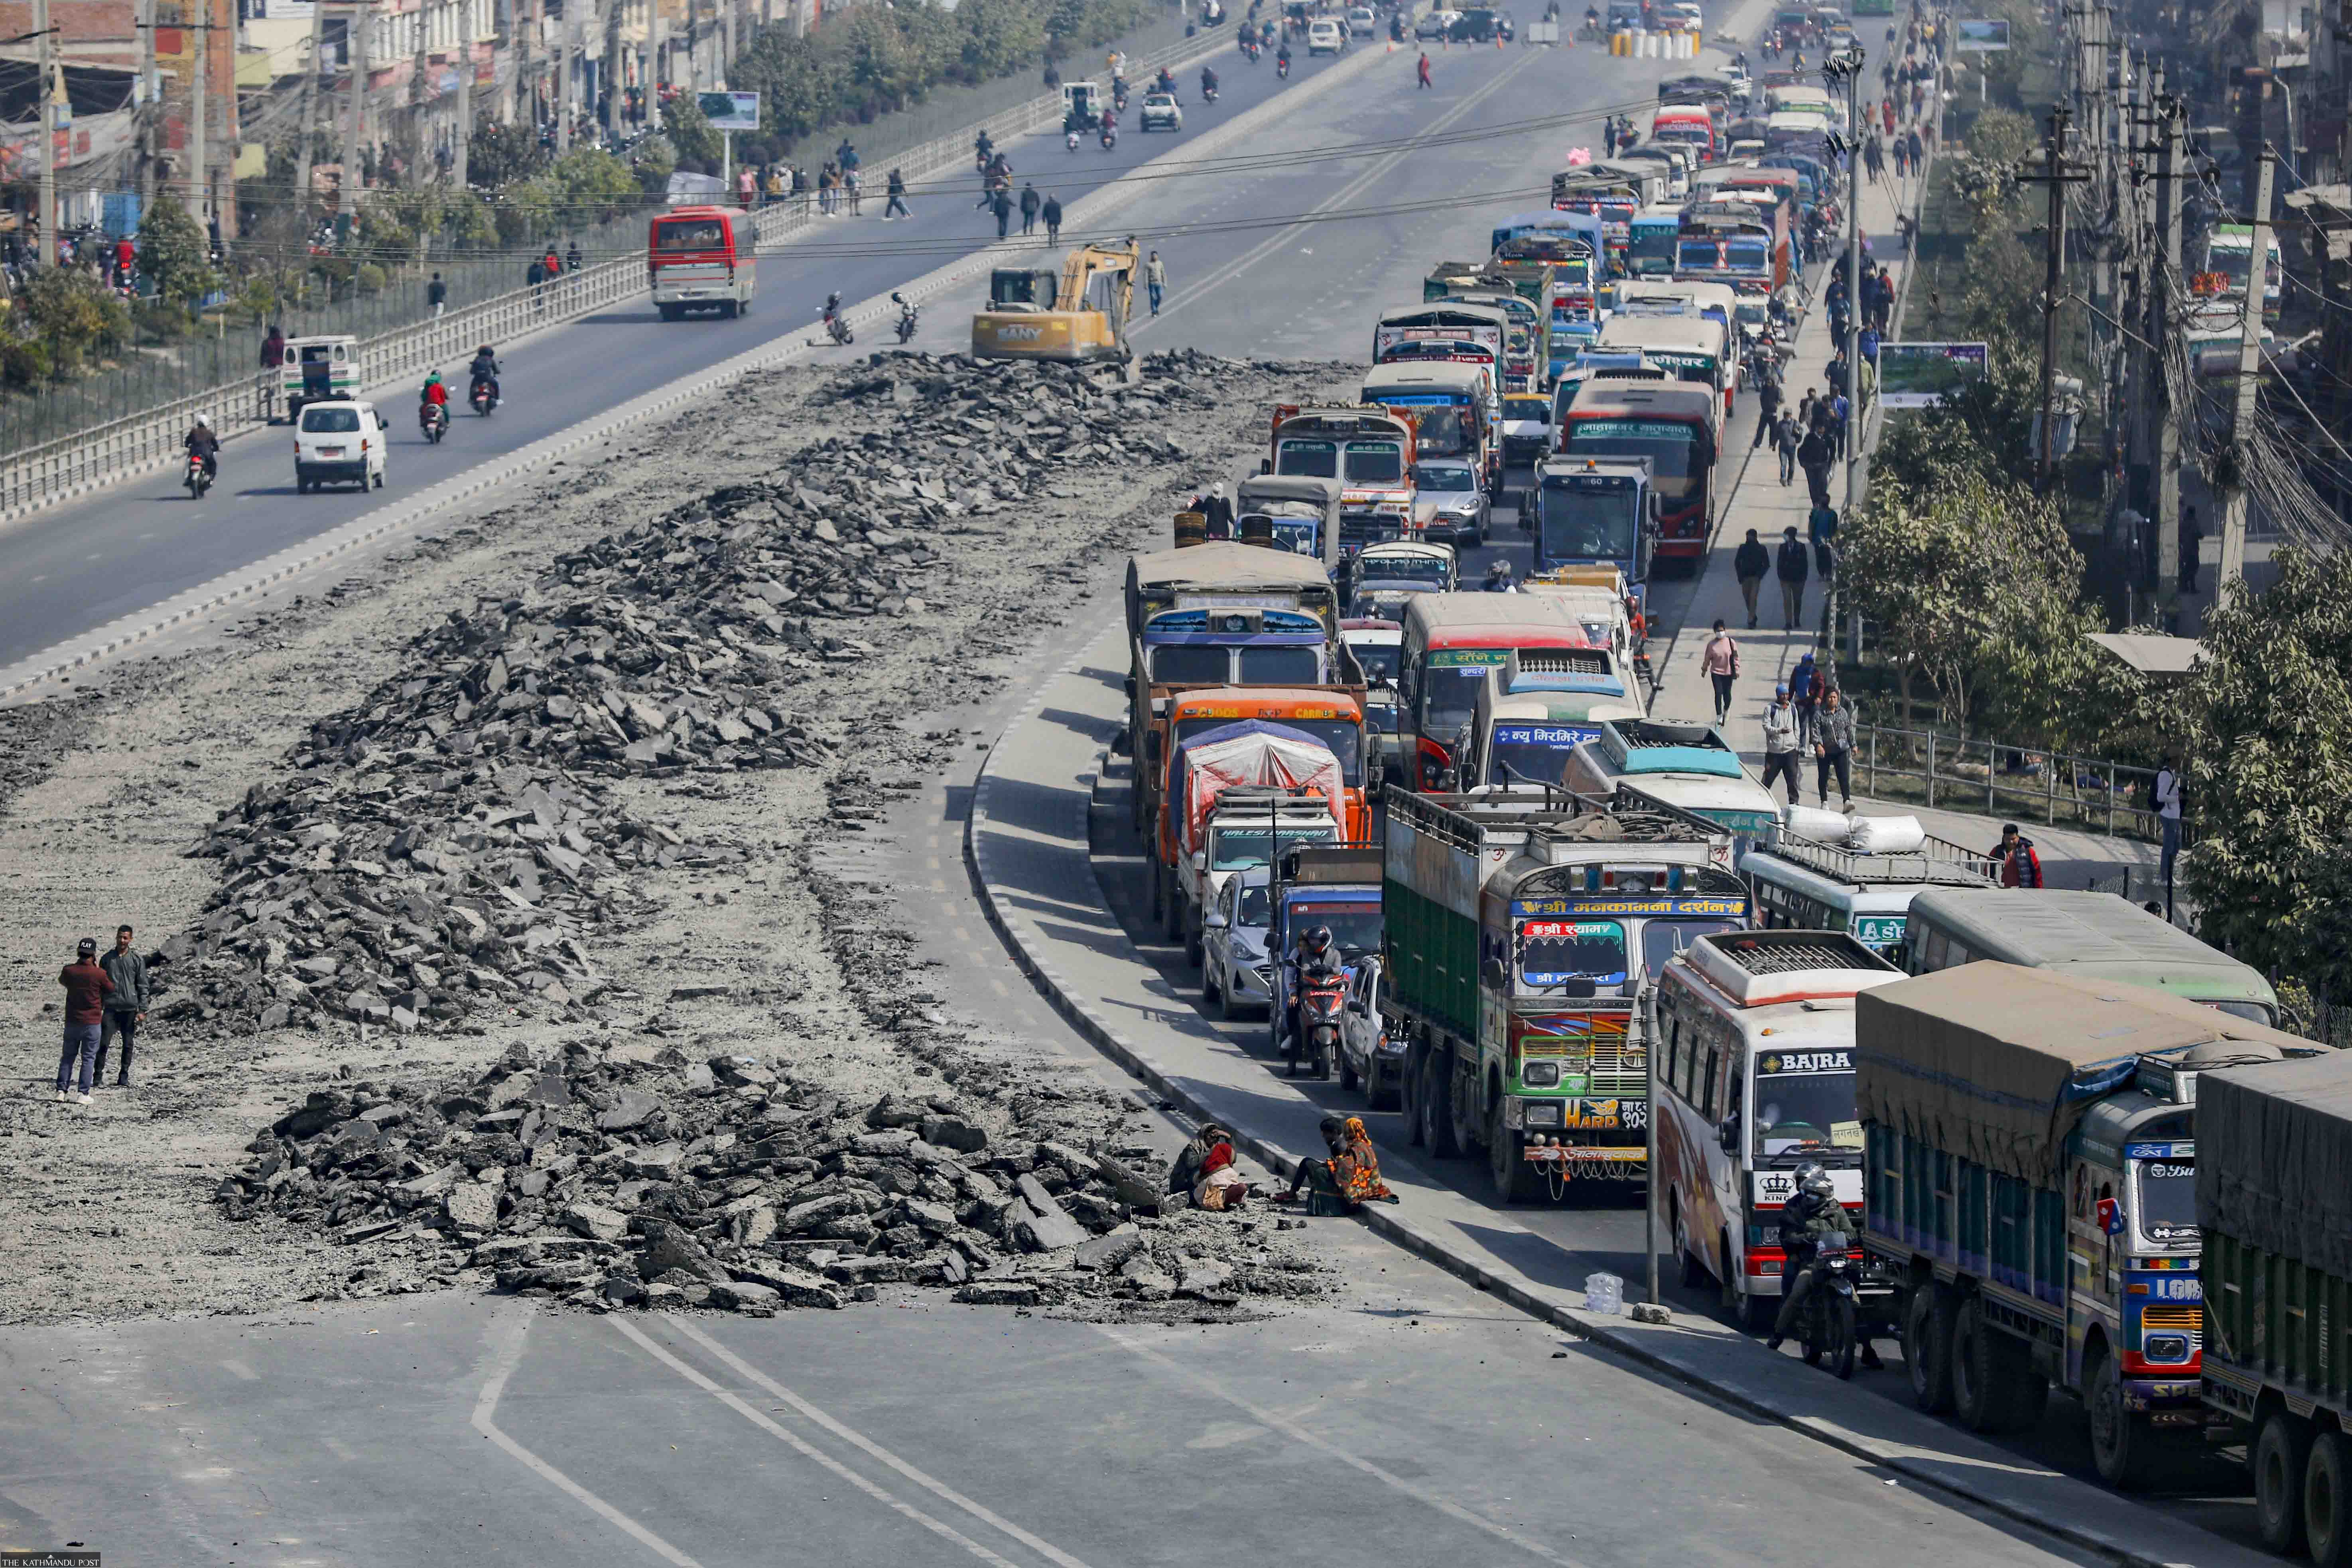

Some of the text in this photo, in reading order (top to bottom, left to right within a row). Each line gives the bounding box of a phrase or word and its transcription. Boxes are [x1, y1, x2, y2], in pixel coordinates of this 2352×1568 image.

[997, 328, 1043, 341] SANY
[1534, 728, 1580, 742] मिरमिरे
[1543, 901, 1726, 914] श्री मनकामना दर्शन
[1544, 924, 1602, 935] श्री श्याम
[1882, 921, 1905, 939] डो
[1535, 973, 1552, 983] श्री
[1781, 1052, 1851, 1071] BAJRA
[1565, 1098, 1619, 1129] HARD
